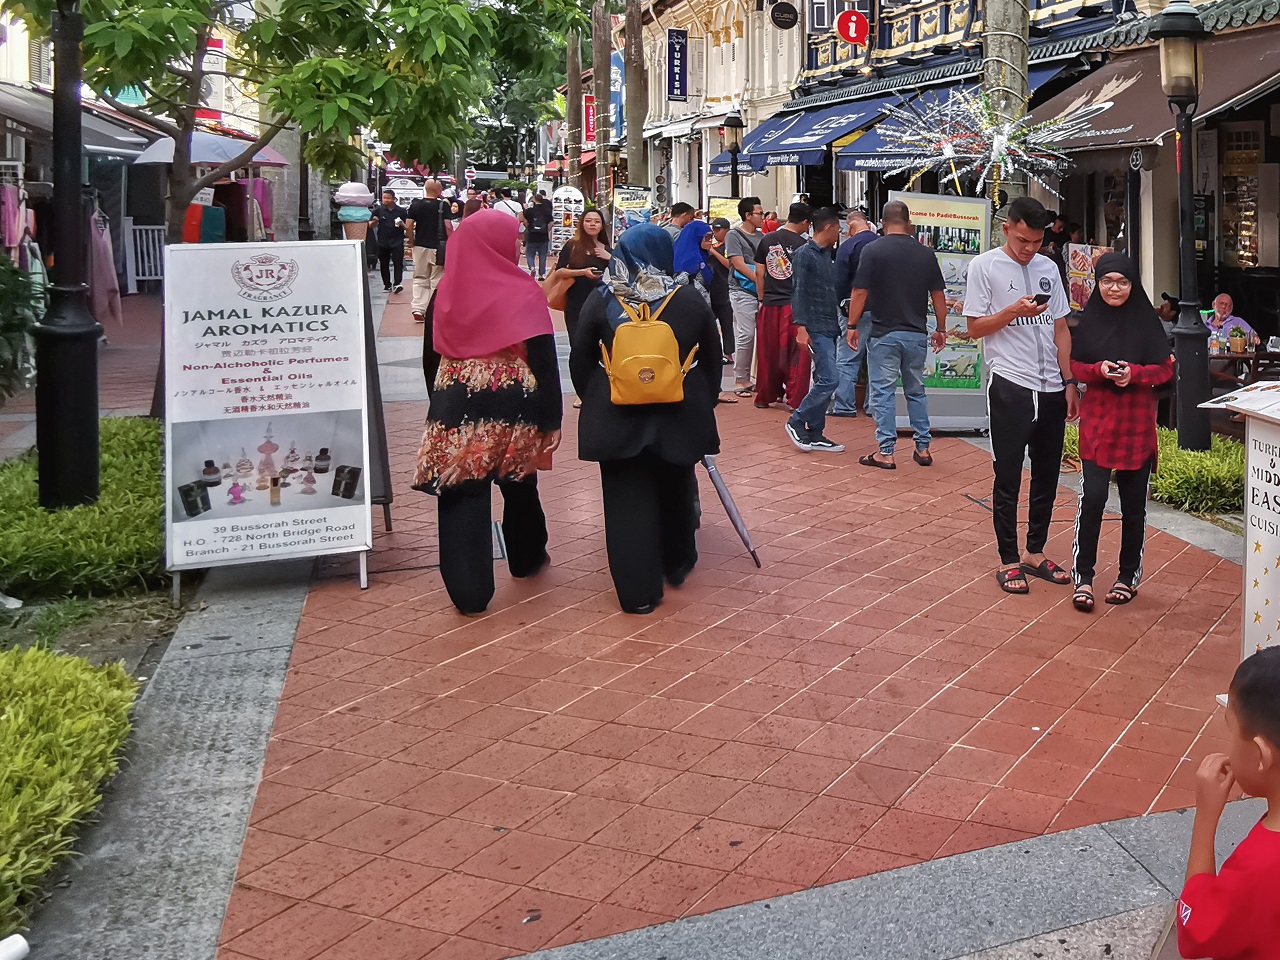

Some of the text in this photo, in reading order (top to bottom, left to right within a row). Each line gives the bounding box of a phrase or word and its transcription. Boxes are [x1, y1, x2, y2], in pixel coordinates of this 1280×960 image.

[1132, 152, 1140, 165] 53
[256, 269, 275, 279] JR
[242, 290, 288, 301] FRAGRANCE
[182, 304, 348, 325] JAMAL KAZURA
[202, 320, 329, 338] AROMATICS
[288, 355, 349, 365] Perfumes
[221, 372, 313, 385] Essential Oils
[213, 516, 327, 534] 39 Bussorah Street
[222, 535, 243, 544] 728
[246, 532, 279, 541] North
[283, 527, 322, 538] Bridge
[325, 523, 356, 532] Road
[185, 546, 229, 557] Branch
[259, 538, 316, 550] Bussorah
[319, 533, 354, 543] Street
